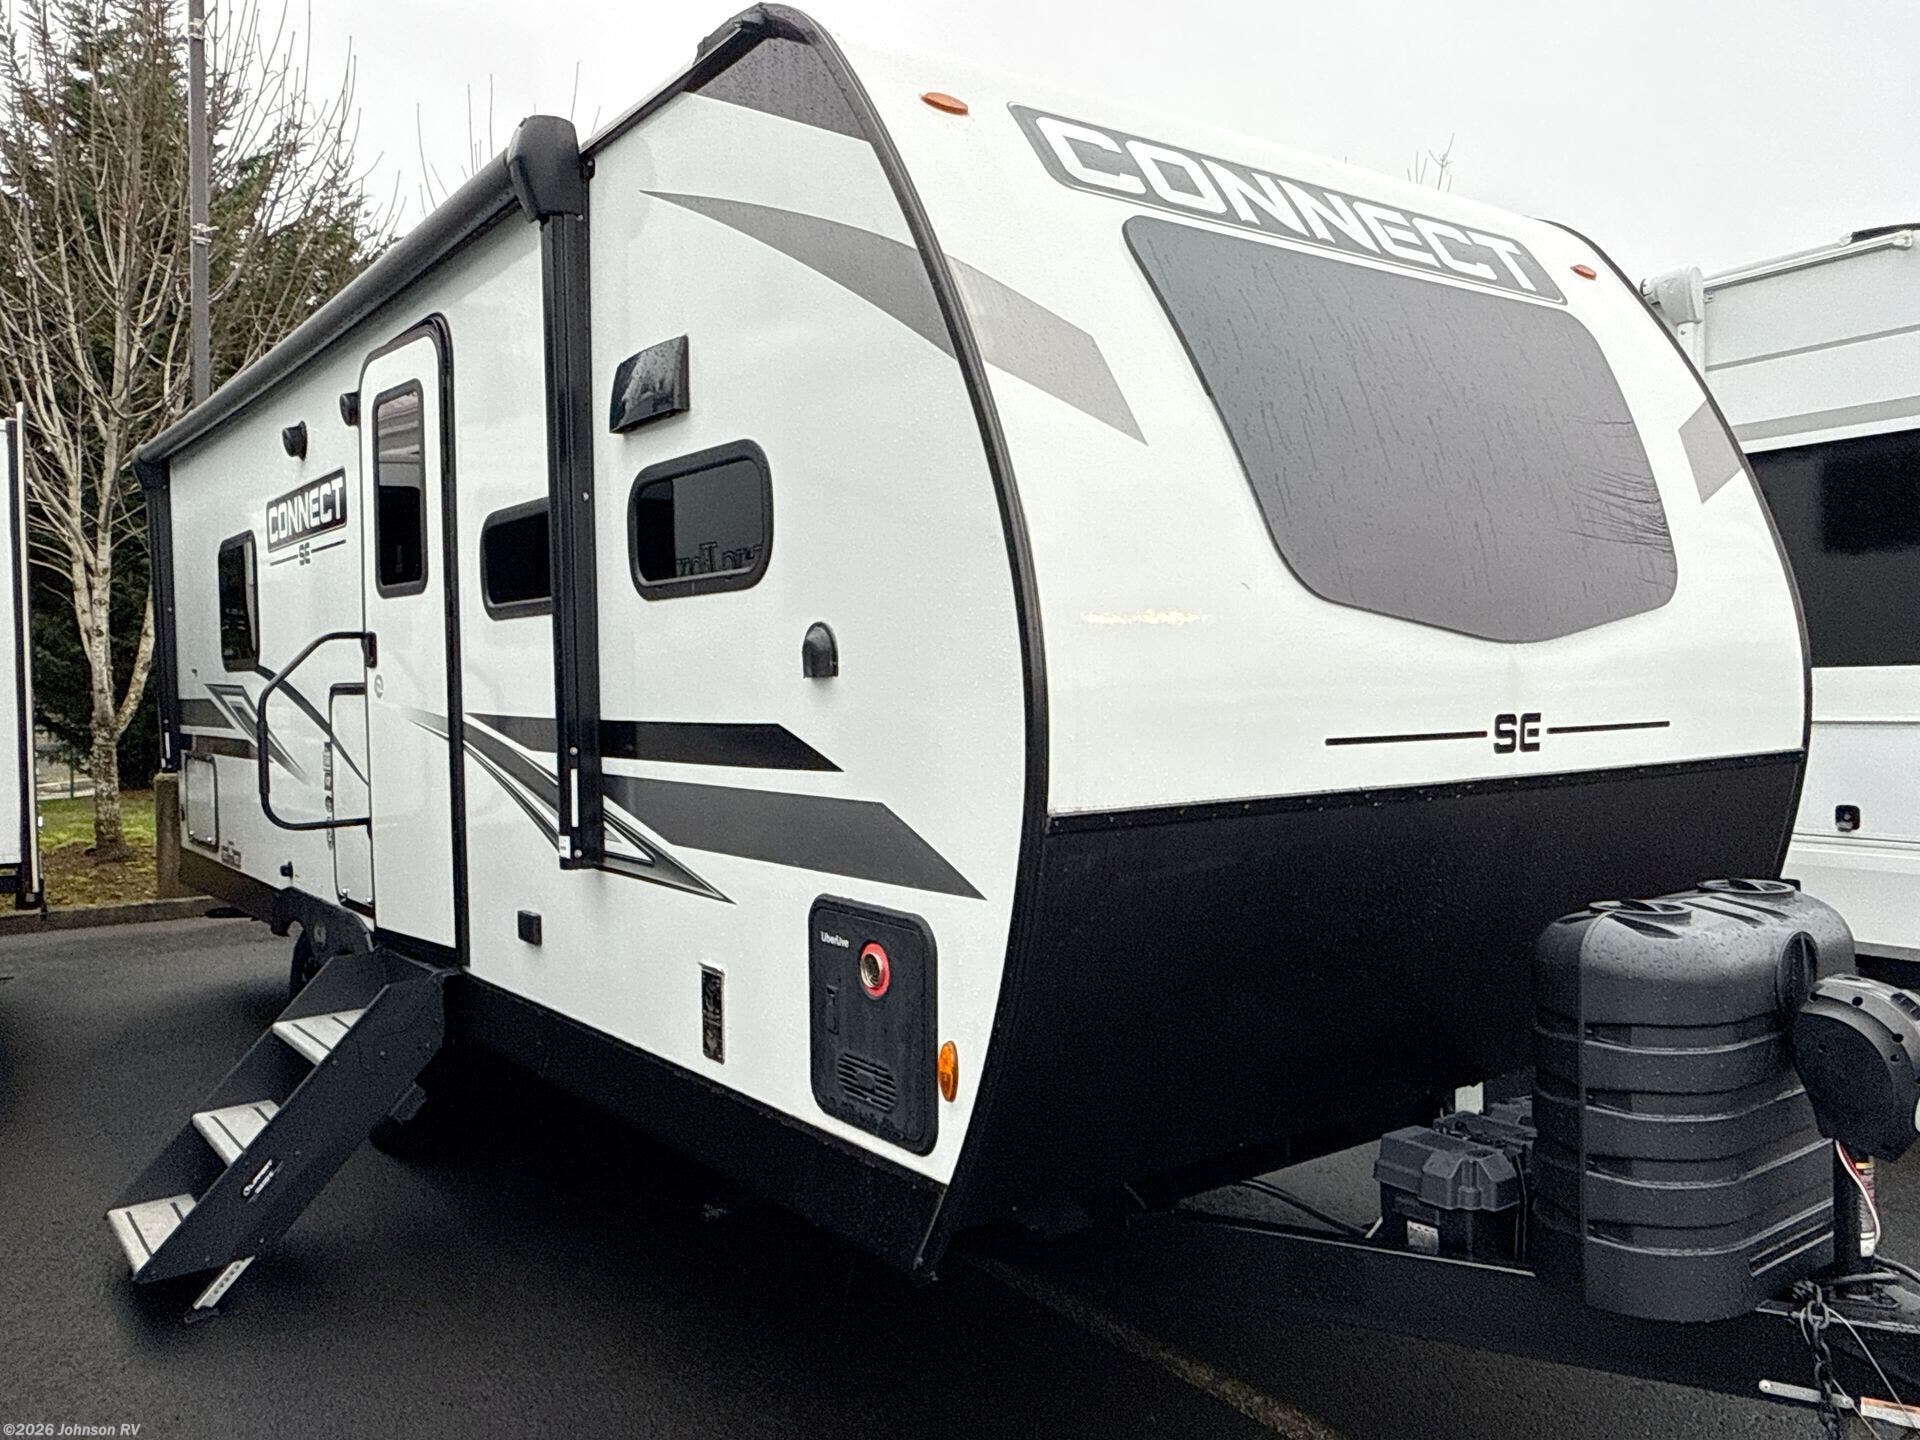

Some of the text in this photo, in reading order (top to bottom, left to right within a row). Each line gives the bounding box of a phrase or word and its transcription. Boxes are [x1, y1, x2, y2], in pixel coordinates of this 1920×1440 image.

[1036, 116, 1537, 291] CONNECT
[268, 477, 343, 543] CONNECT
[1493, 712, 1541, 754] SE
